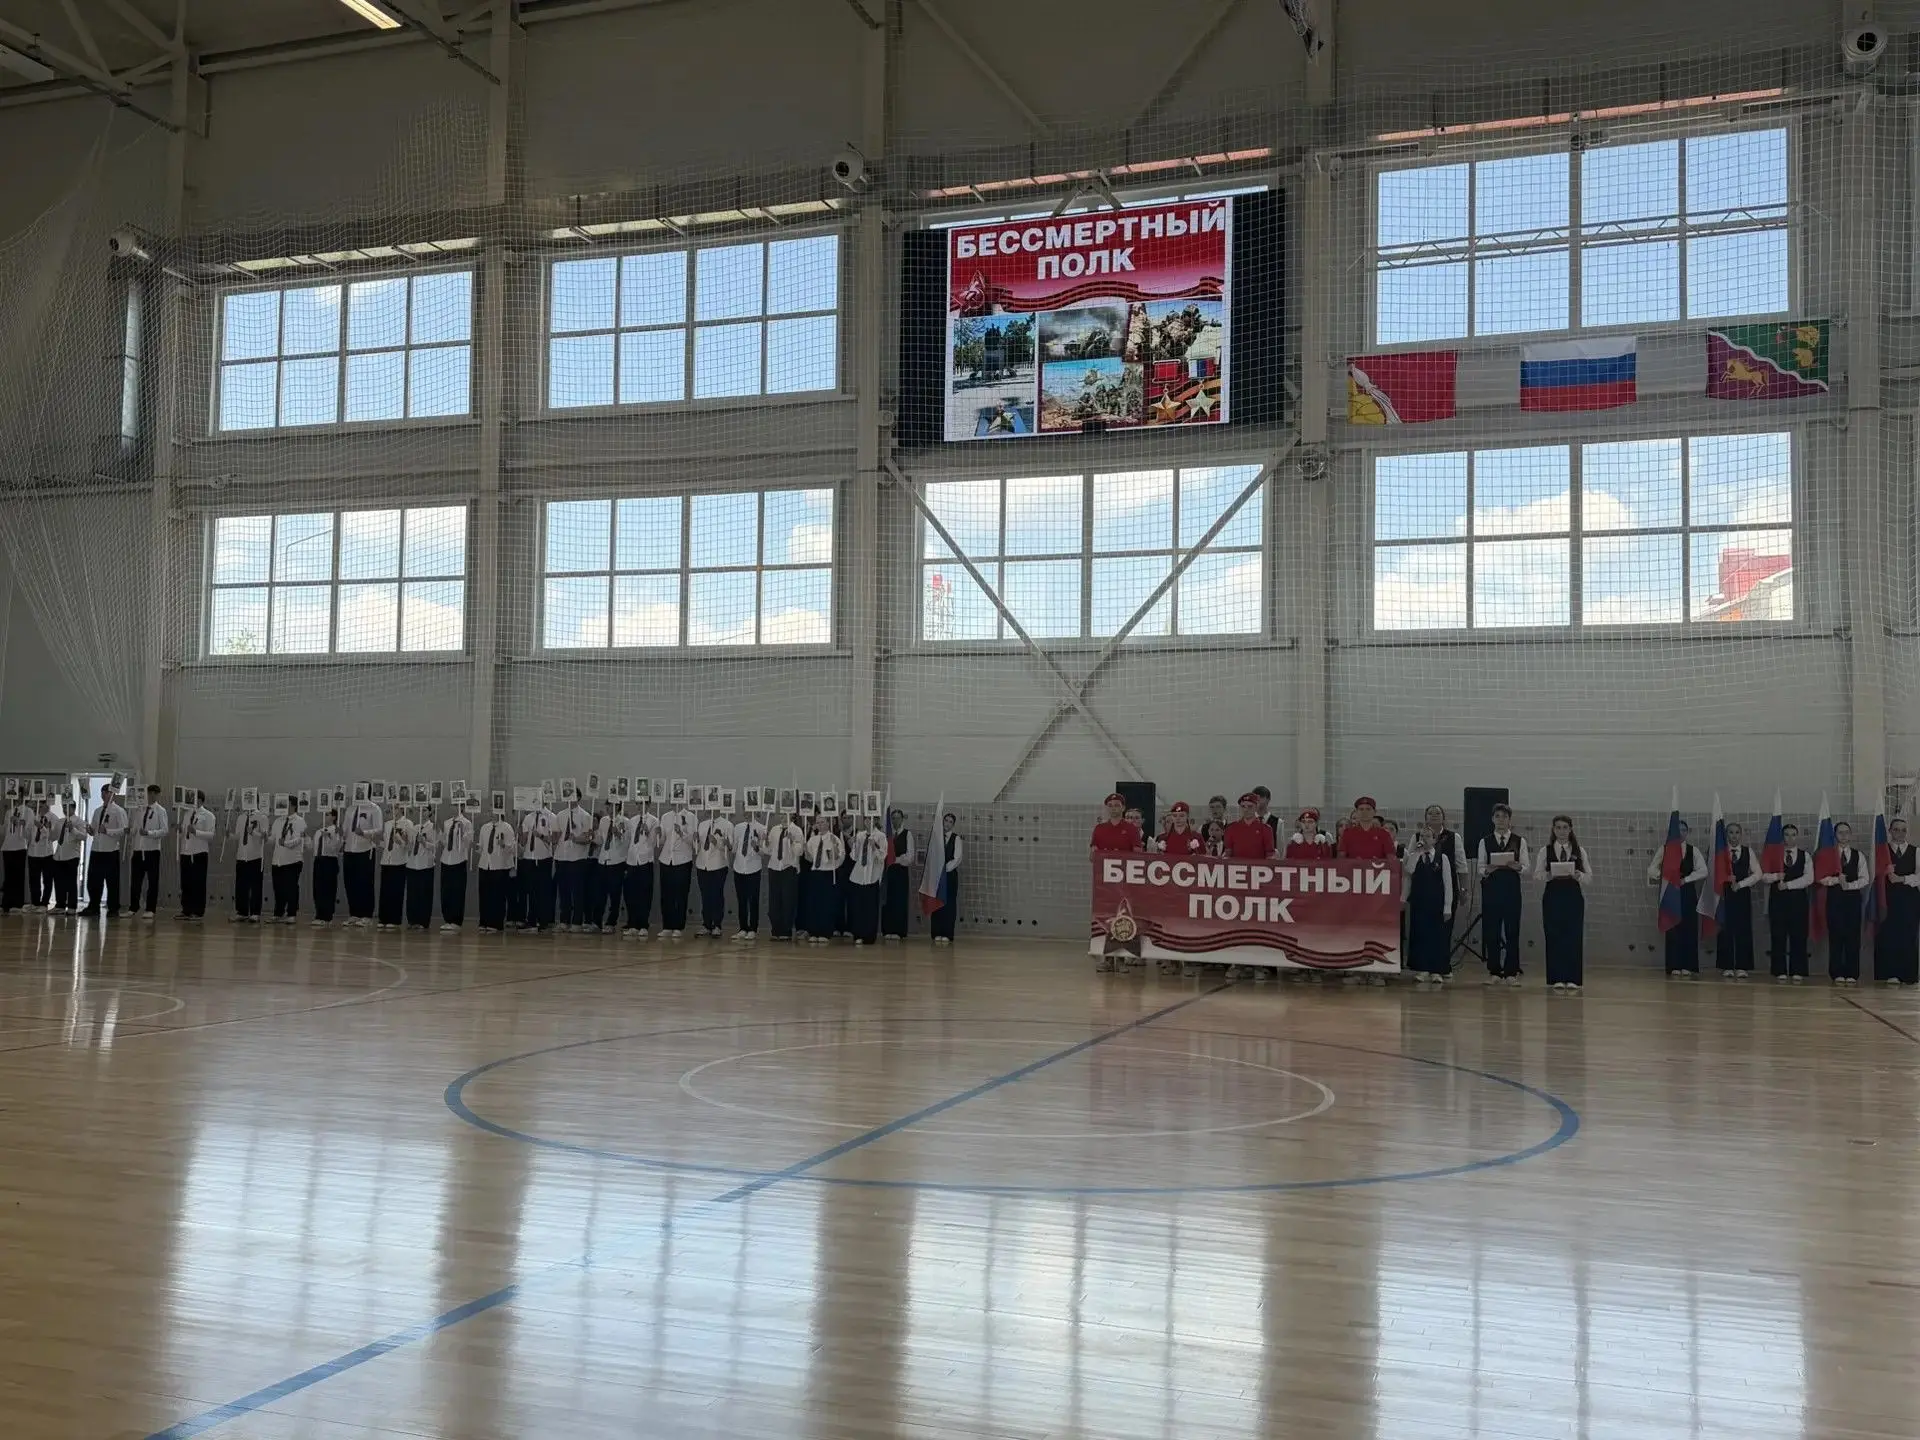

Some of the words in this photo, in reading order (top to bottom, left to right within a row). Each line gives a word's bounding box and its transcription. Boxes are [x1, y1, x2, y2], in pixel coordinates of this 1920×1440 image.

[957, 201, 1226, 258] БЕССМЕРТНЫЙ
[1037, 247, 1135, 280] ПОЛК
[1102, 858, 1391, 895] БЕССМЕРТНЫЙ
[1188, 893, 1295, 924] ПОЛК
